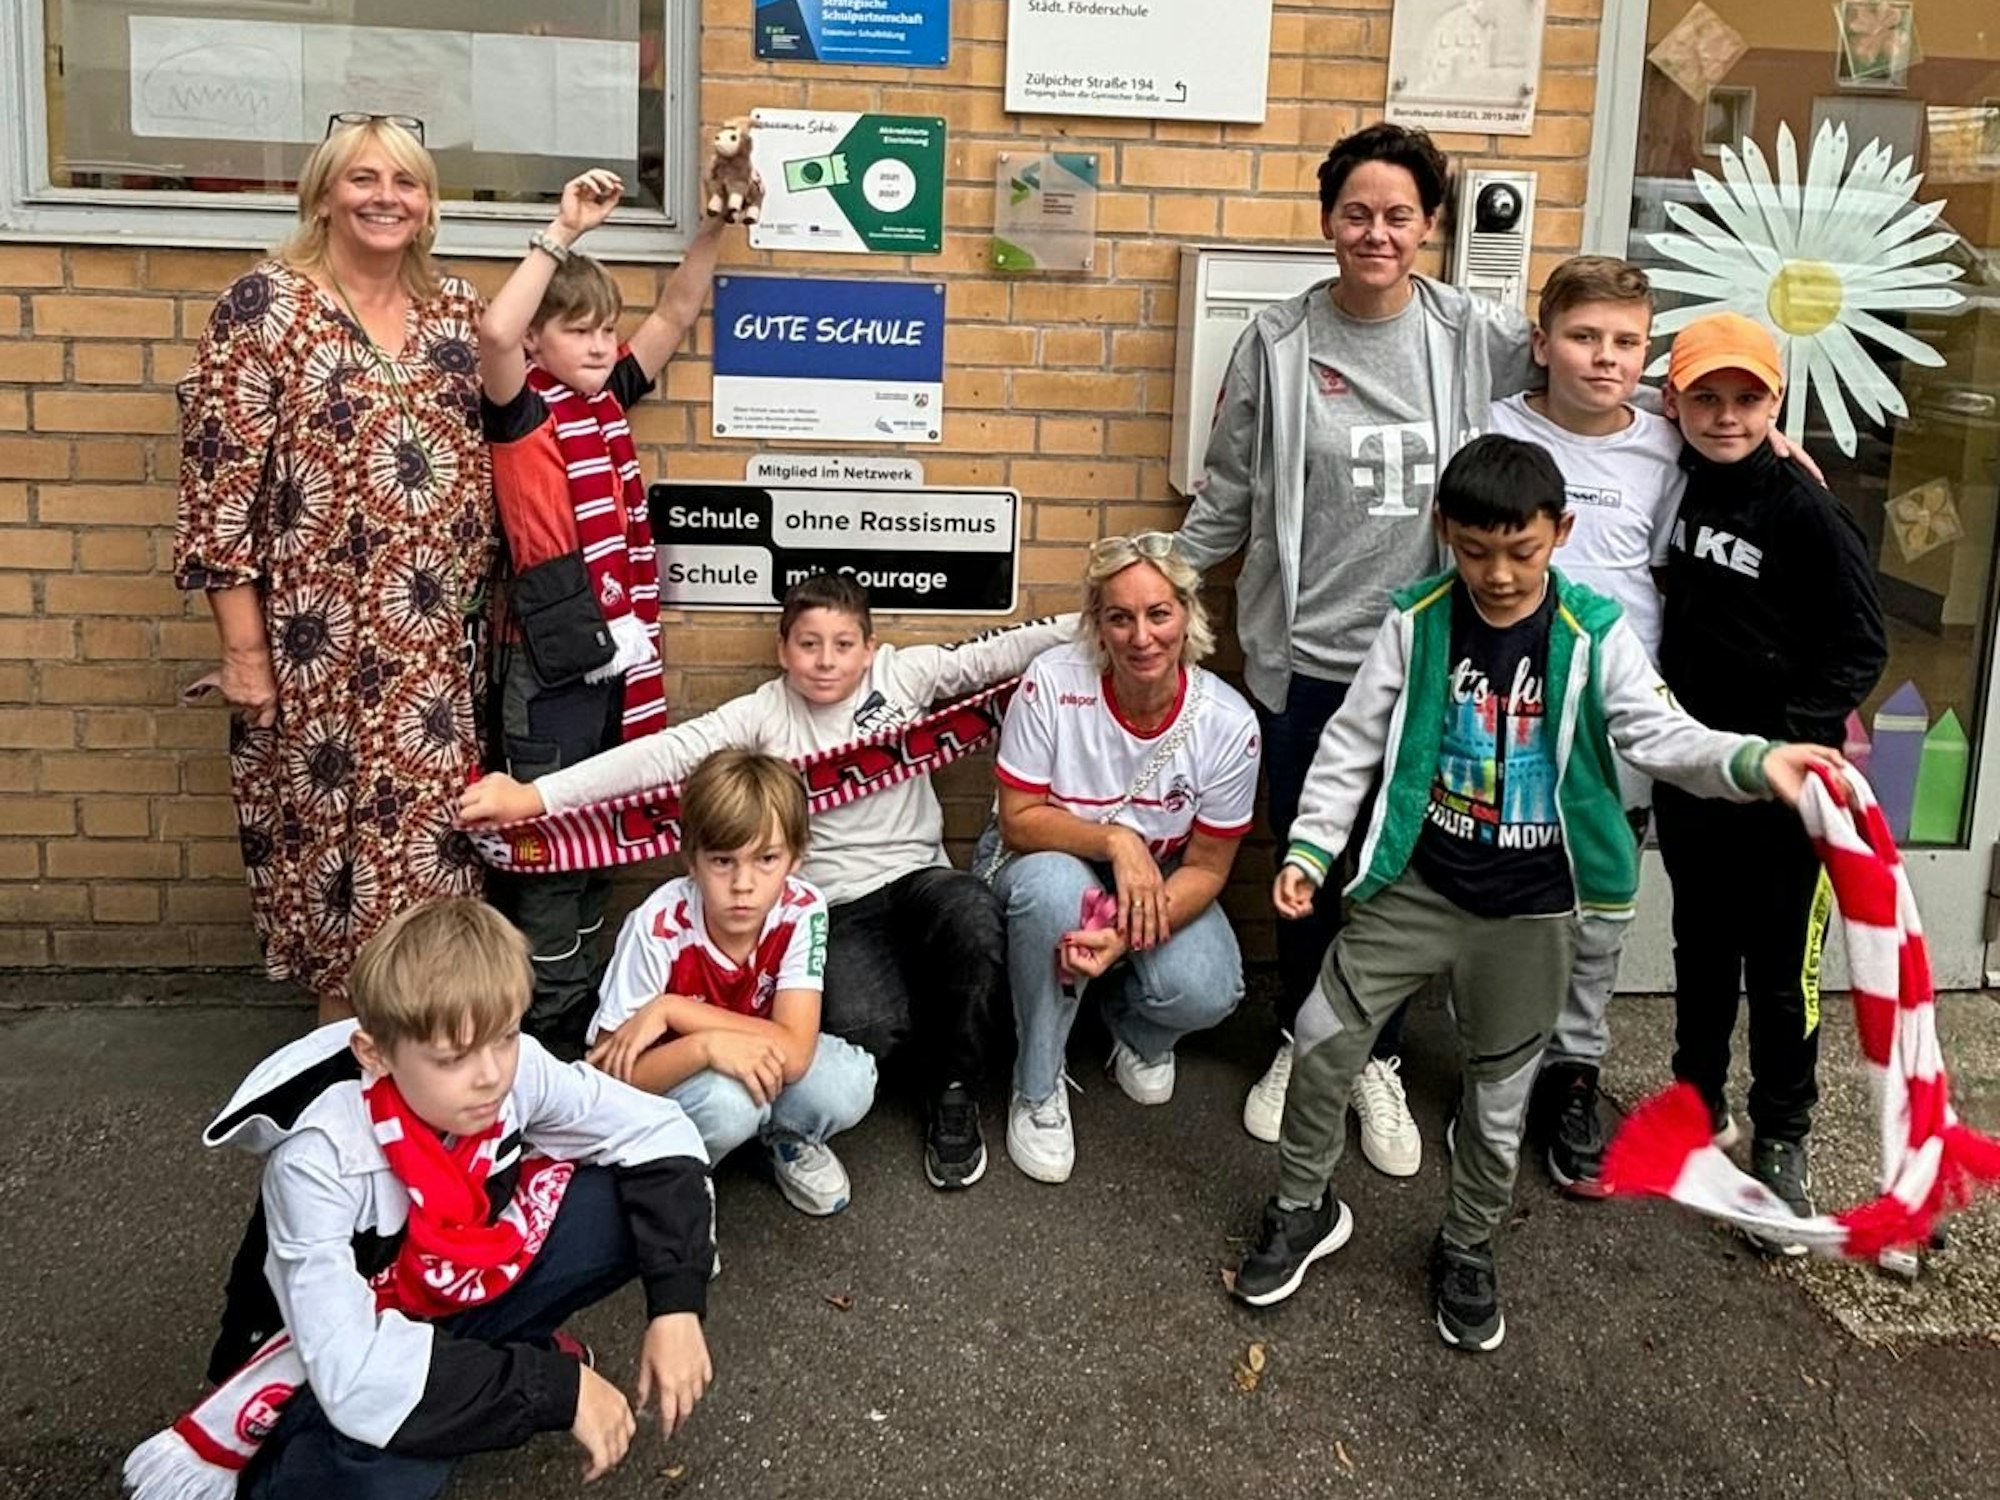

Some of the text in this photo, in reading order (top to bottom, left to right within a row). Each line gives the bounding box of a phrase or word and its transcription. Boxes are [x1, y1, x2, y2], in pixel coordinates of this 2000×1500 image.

[822, 9, 923, 25] Schulpartnerschaft
[1068, 1, 1149, 17] Förderschule
[1026, 72, 1154, 90] Zülpicher Straße 194
[733, 314, 926, 346] GUTE SCHULE
[758, 464, 914, 481] Mitglied im Netzwerk
[668, 506, 996, 533] Schule ohne Rassismus
[668, 563, 759, 585] Schule
[837, 565, 948, 593] ourage
